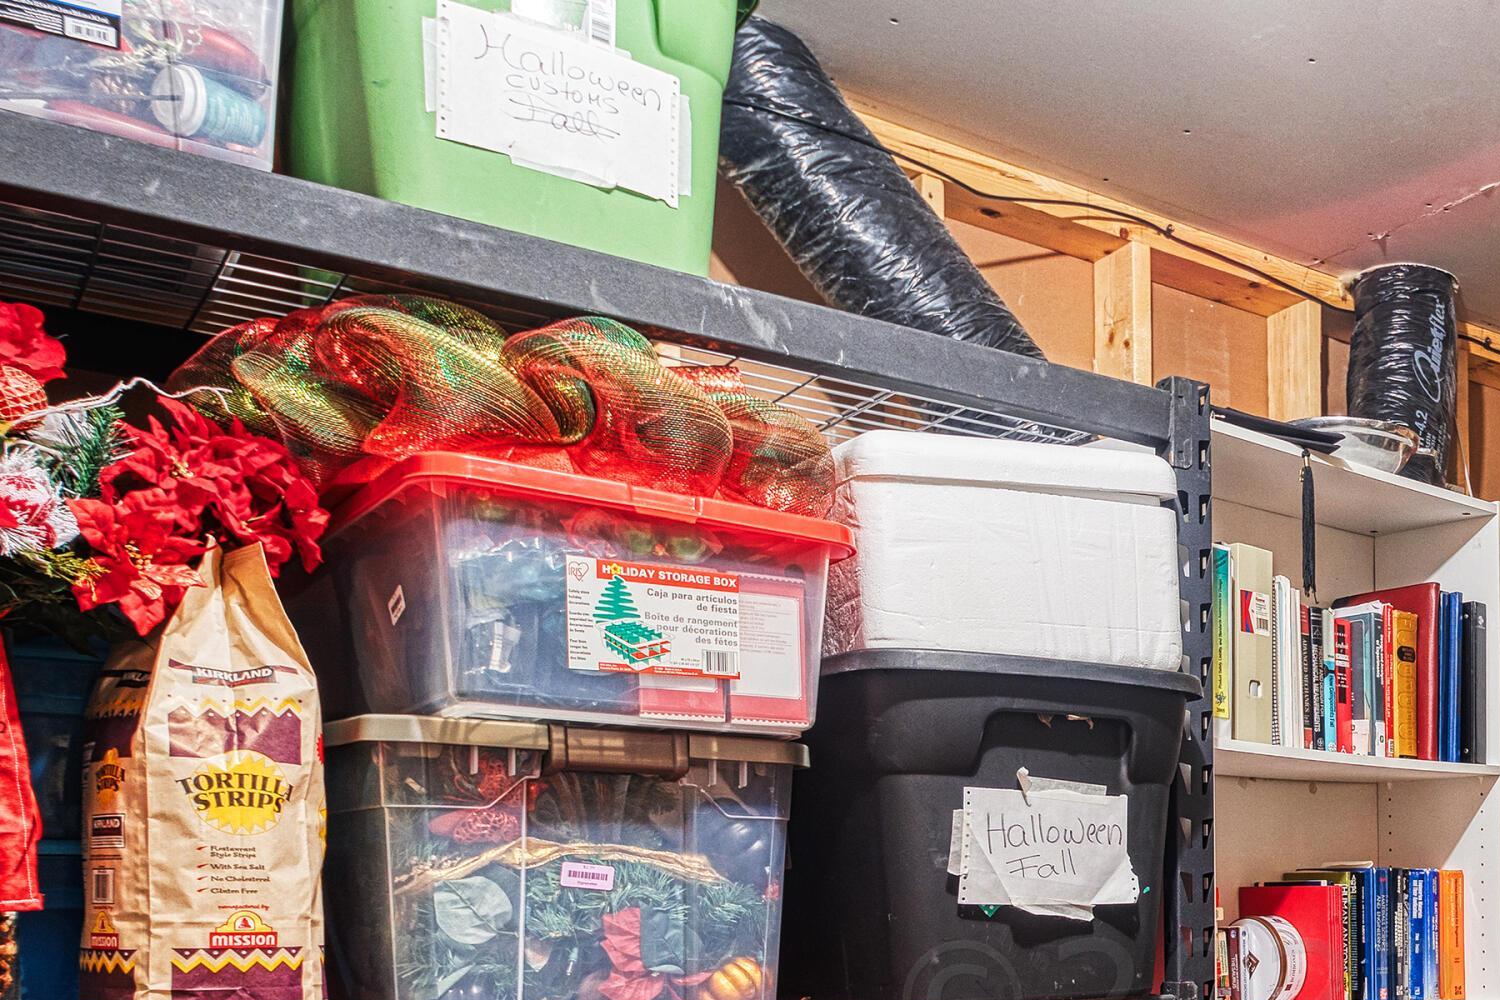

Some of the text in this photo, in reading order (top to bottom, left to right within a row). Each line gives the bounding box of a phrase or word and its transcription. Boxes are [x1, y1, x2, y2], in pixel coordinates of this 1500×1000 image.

[475, 24, 661, 111] Halloween
[658, 570, 711, 585] STORAGE
[713, 577, 737, 588] BOX
[646, 587, 738, 605] Caja para artículos
[696, 602, 738, 614] de fiesta
[644, 611, 738, 628] Boîte de rangement
[656, 623, 738, 637] pour décorations
[695, 636, 738, 647] des fêtes
[1312, 643, 1320, 683] MECHANICAL
[196, 667, 273, 682] KIRKLAND
[193, 790, 285, 813] STRIPS
[987, 812, 1122, 855] Halloween
[1006, 848, 1076, 879] Fall
